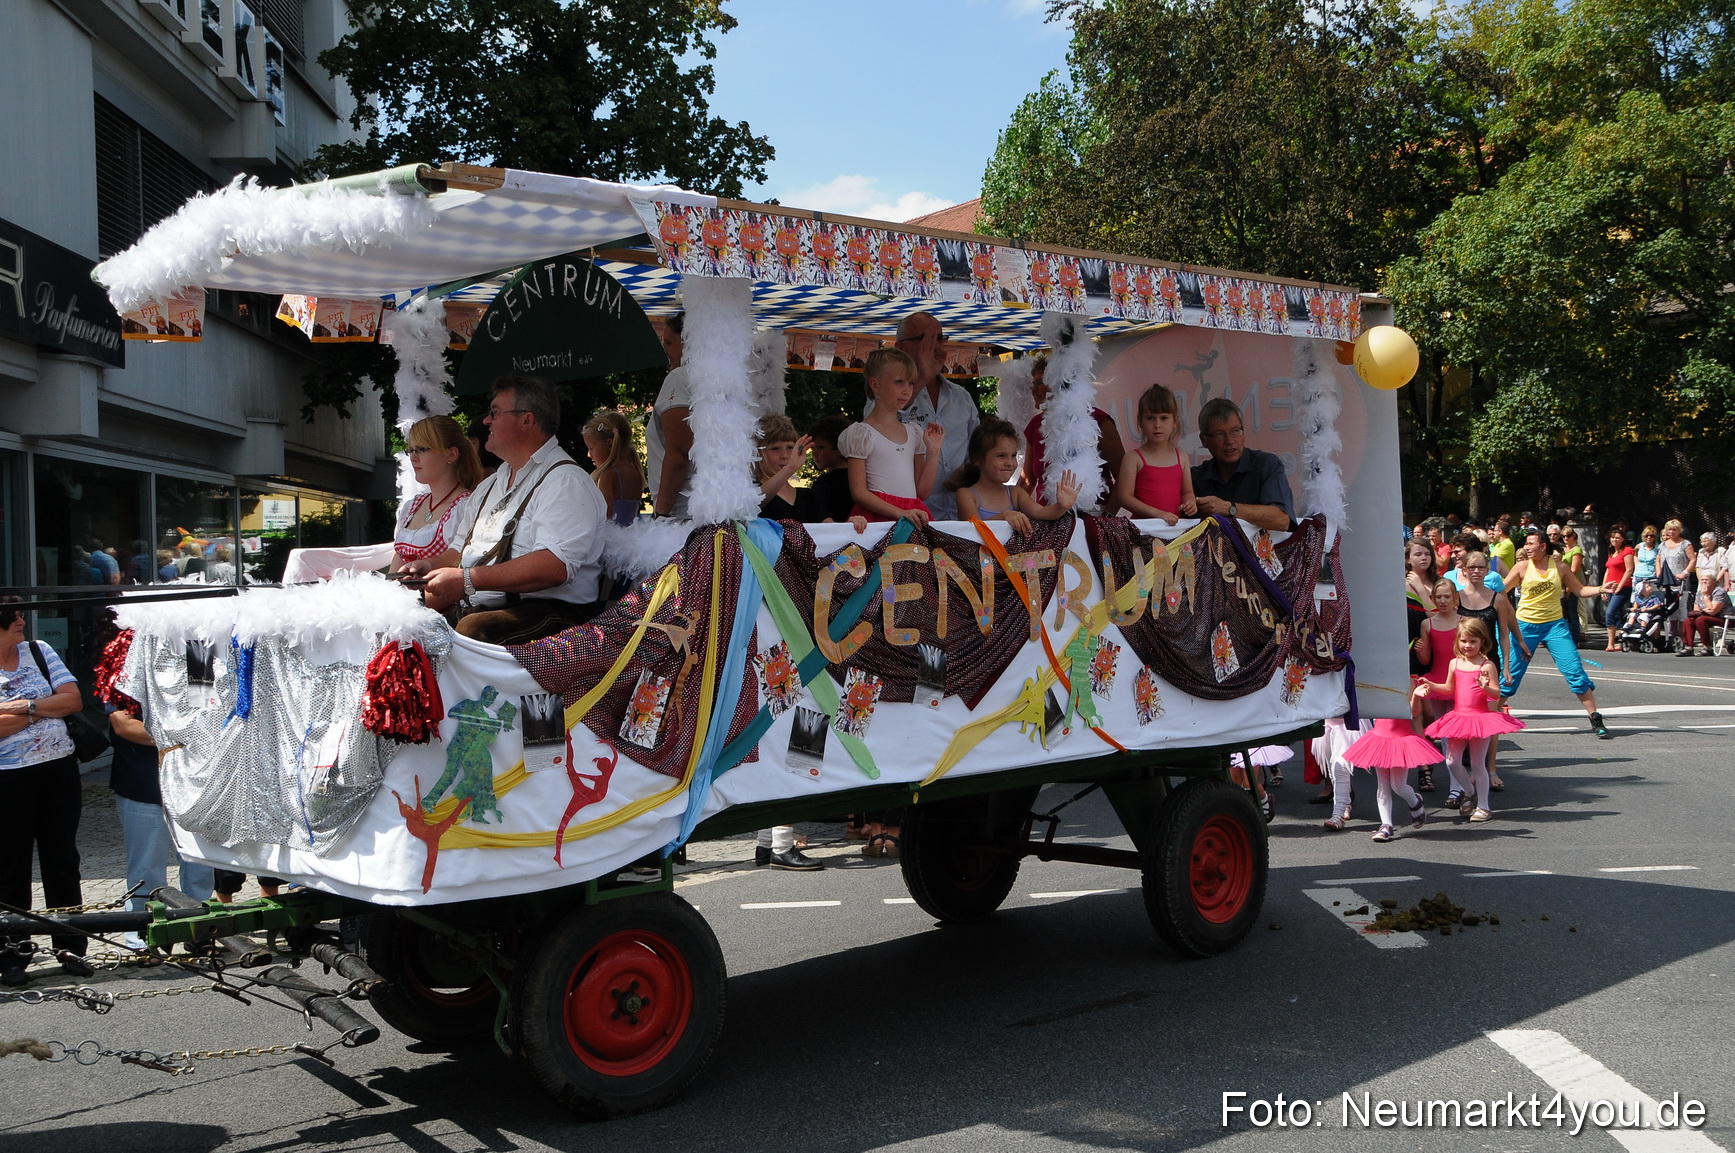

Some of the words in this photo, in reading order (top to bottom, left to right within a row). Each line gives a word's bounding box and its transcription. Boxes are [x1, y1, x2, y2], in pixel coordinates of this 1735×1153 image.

[160, 0, 286, 127] EKE
[140, 304, 160, 318] FIT
[487, 263, 623, 342] CENTRUM
[180, 308, 198, 321] FIT
[328, 311, 344, 323] FIT
[360, 311, 376, 323] FIT
[512, 349, 572, 372] Neumarkt
[814, 538, 1195, 664] CENTRUM
